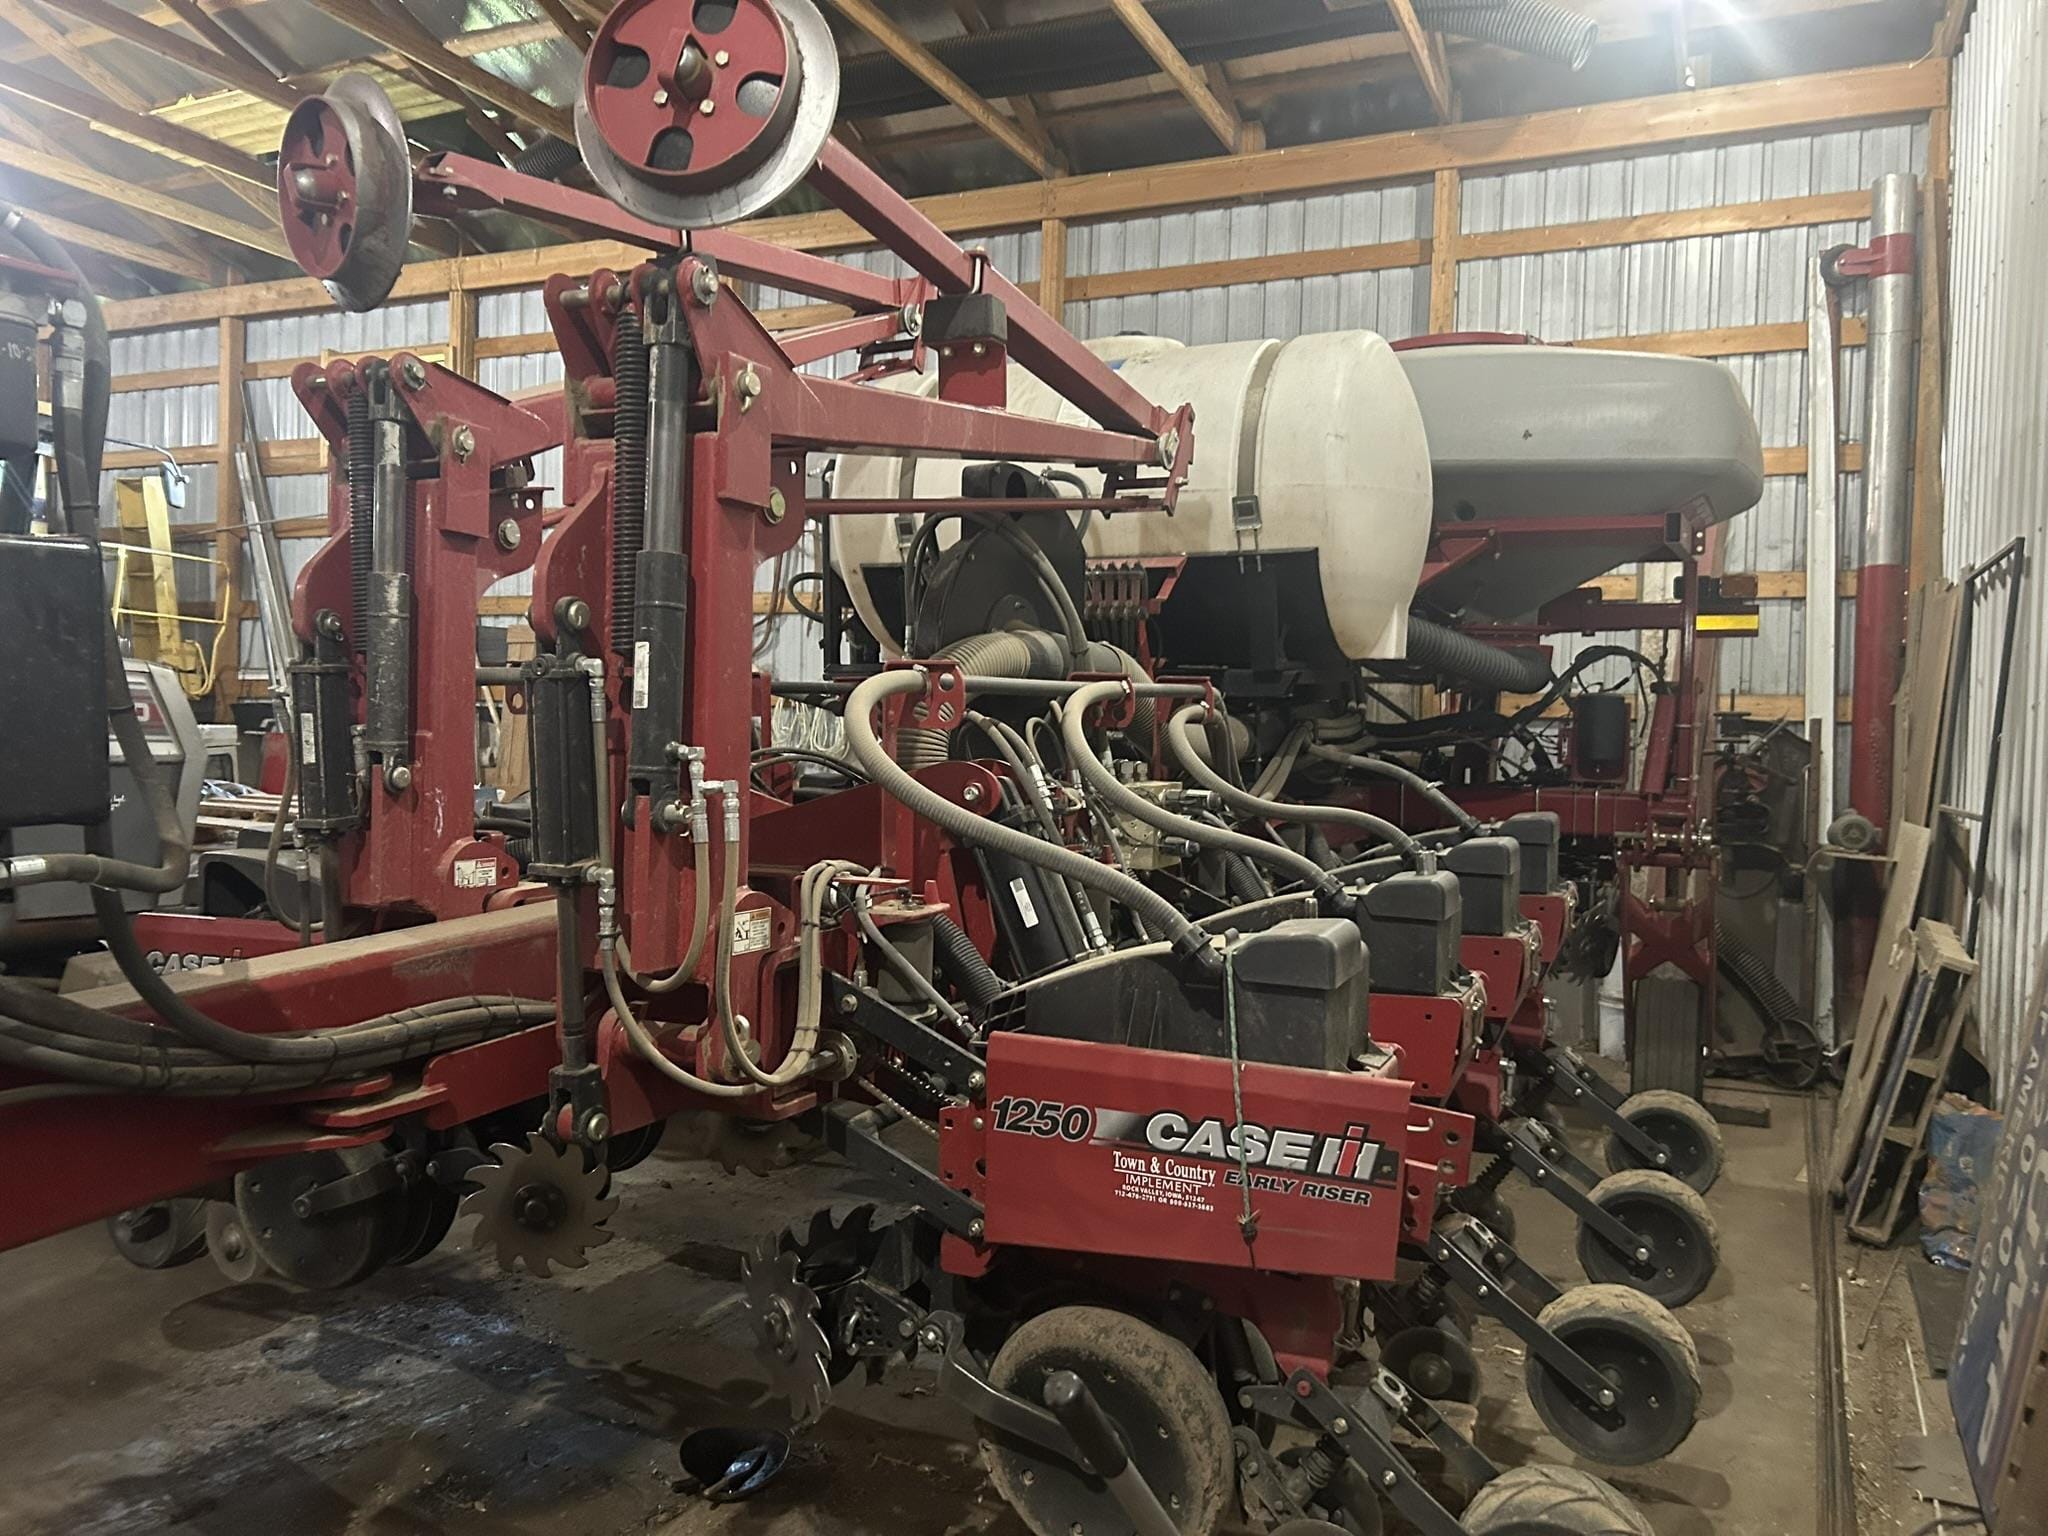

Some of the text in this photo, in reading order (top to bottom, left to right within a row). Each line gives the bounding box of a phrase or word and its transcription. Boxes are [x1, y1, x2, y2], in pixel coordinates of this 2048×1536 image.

[991, 1096, 1091, 1142] 1250
[1146, 1113, 1315, 1172] CASE
[1112, 1151, 1217, 1187] Town & Country
[1122, 1184, 1139, 1193] ROCK
[1125, 1173, 1202, 1195] IMPLEMENT
[1223, 1170, 1372, 1207] EARLY RISER
[1158, 1196, 1168, 1204] OR
